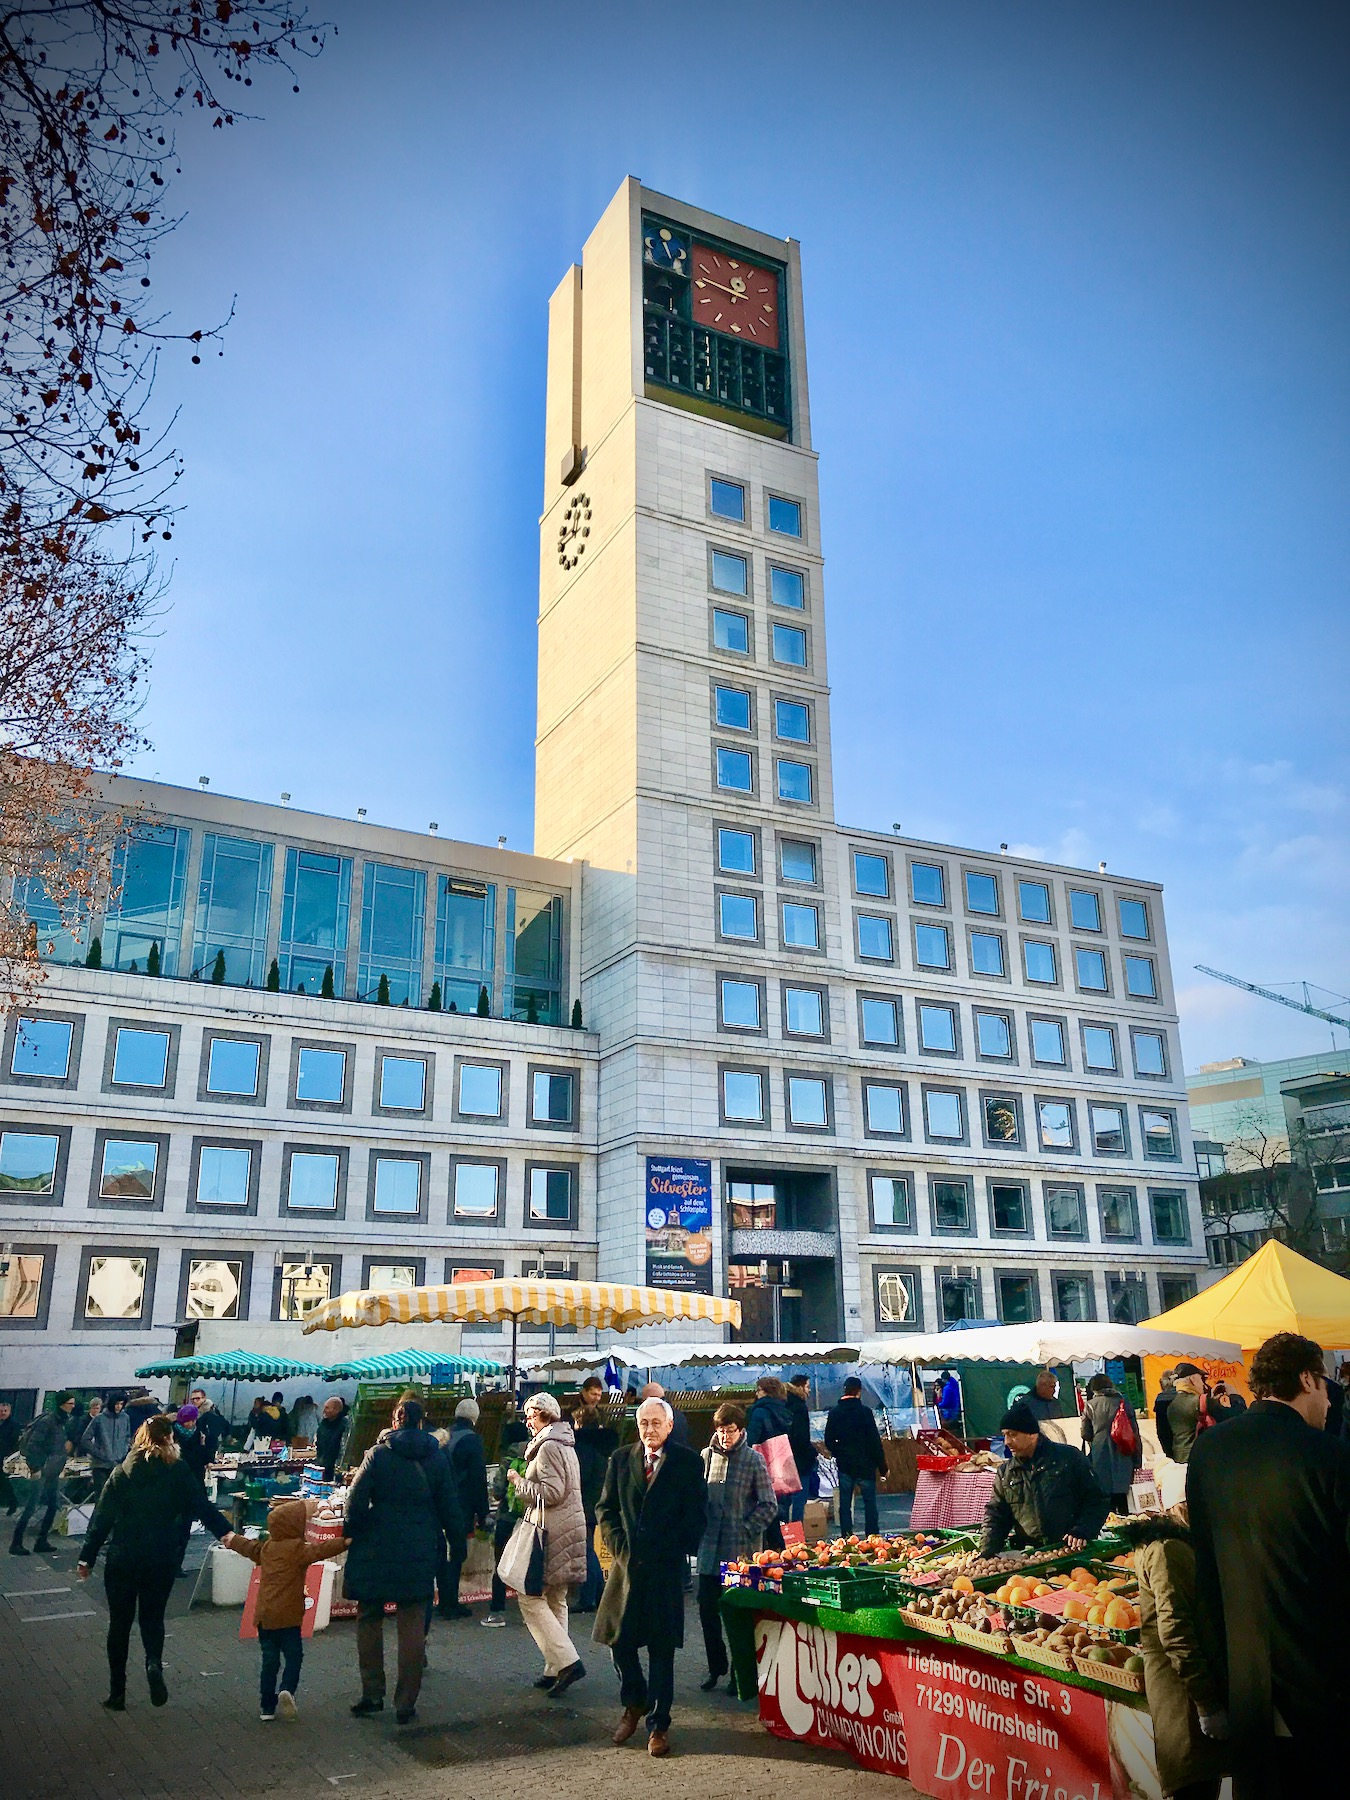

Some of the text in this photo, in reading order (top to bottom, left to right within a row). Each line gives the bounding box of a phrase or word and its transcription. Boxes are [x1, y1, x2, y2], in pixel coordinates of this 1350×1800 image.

[650, 1177, 708, 1198] Silvester
[651, 1164, 670, 1173] Stuttgart
[1202, 1361, 1237, 1380] Stefans
[754, 1619, 882, 1735] Müller
[906, 1647, 1073, 1716] Tiefenbronner Str. 3
[817, 1707, 908, 1765] CHAMPIGNONS
[883, 1709, 904, 1726] GmbH
[916, 1684, 1060, 1751] 71299 Wimsheim
[934, 1733, 996, 1795] Der
